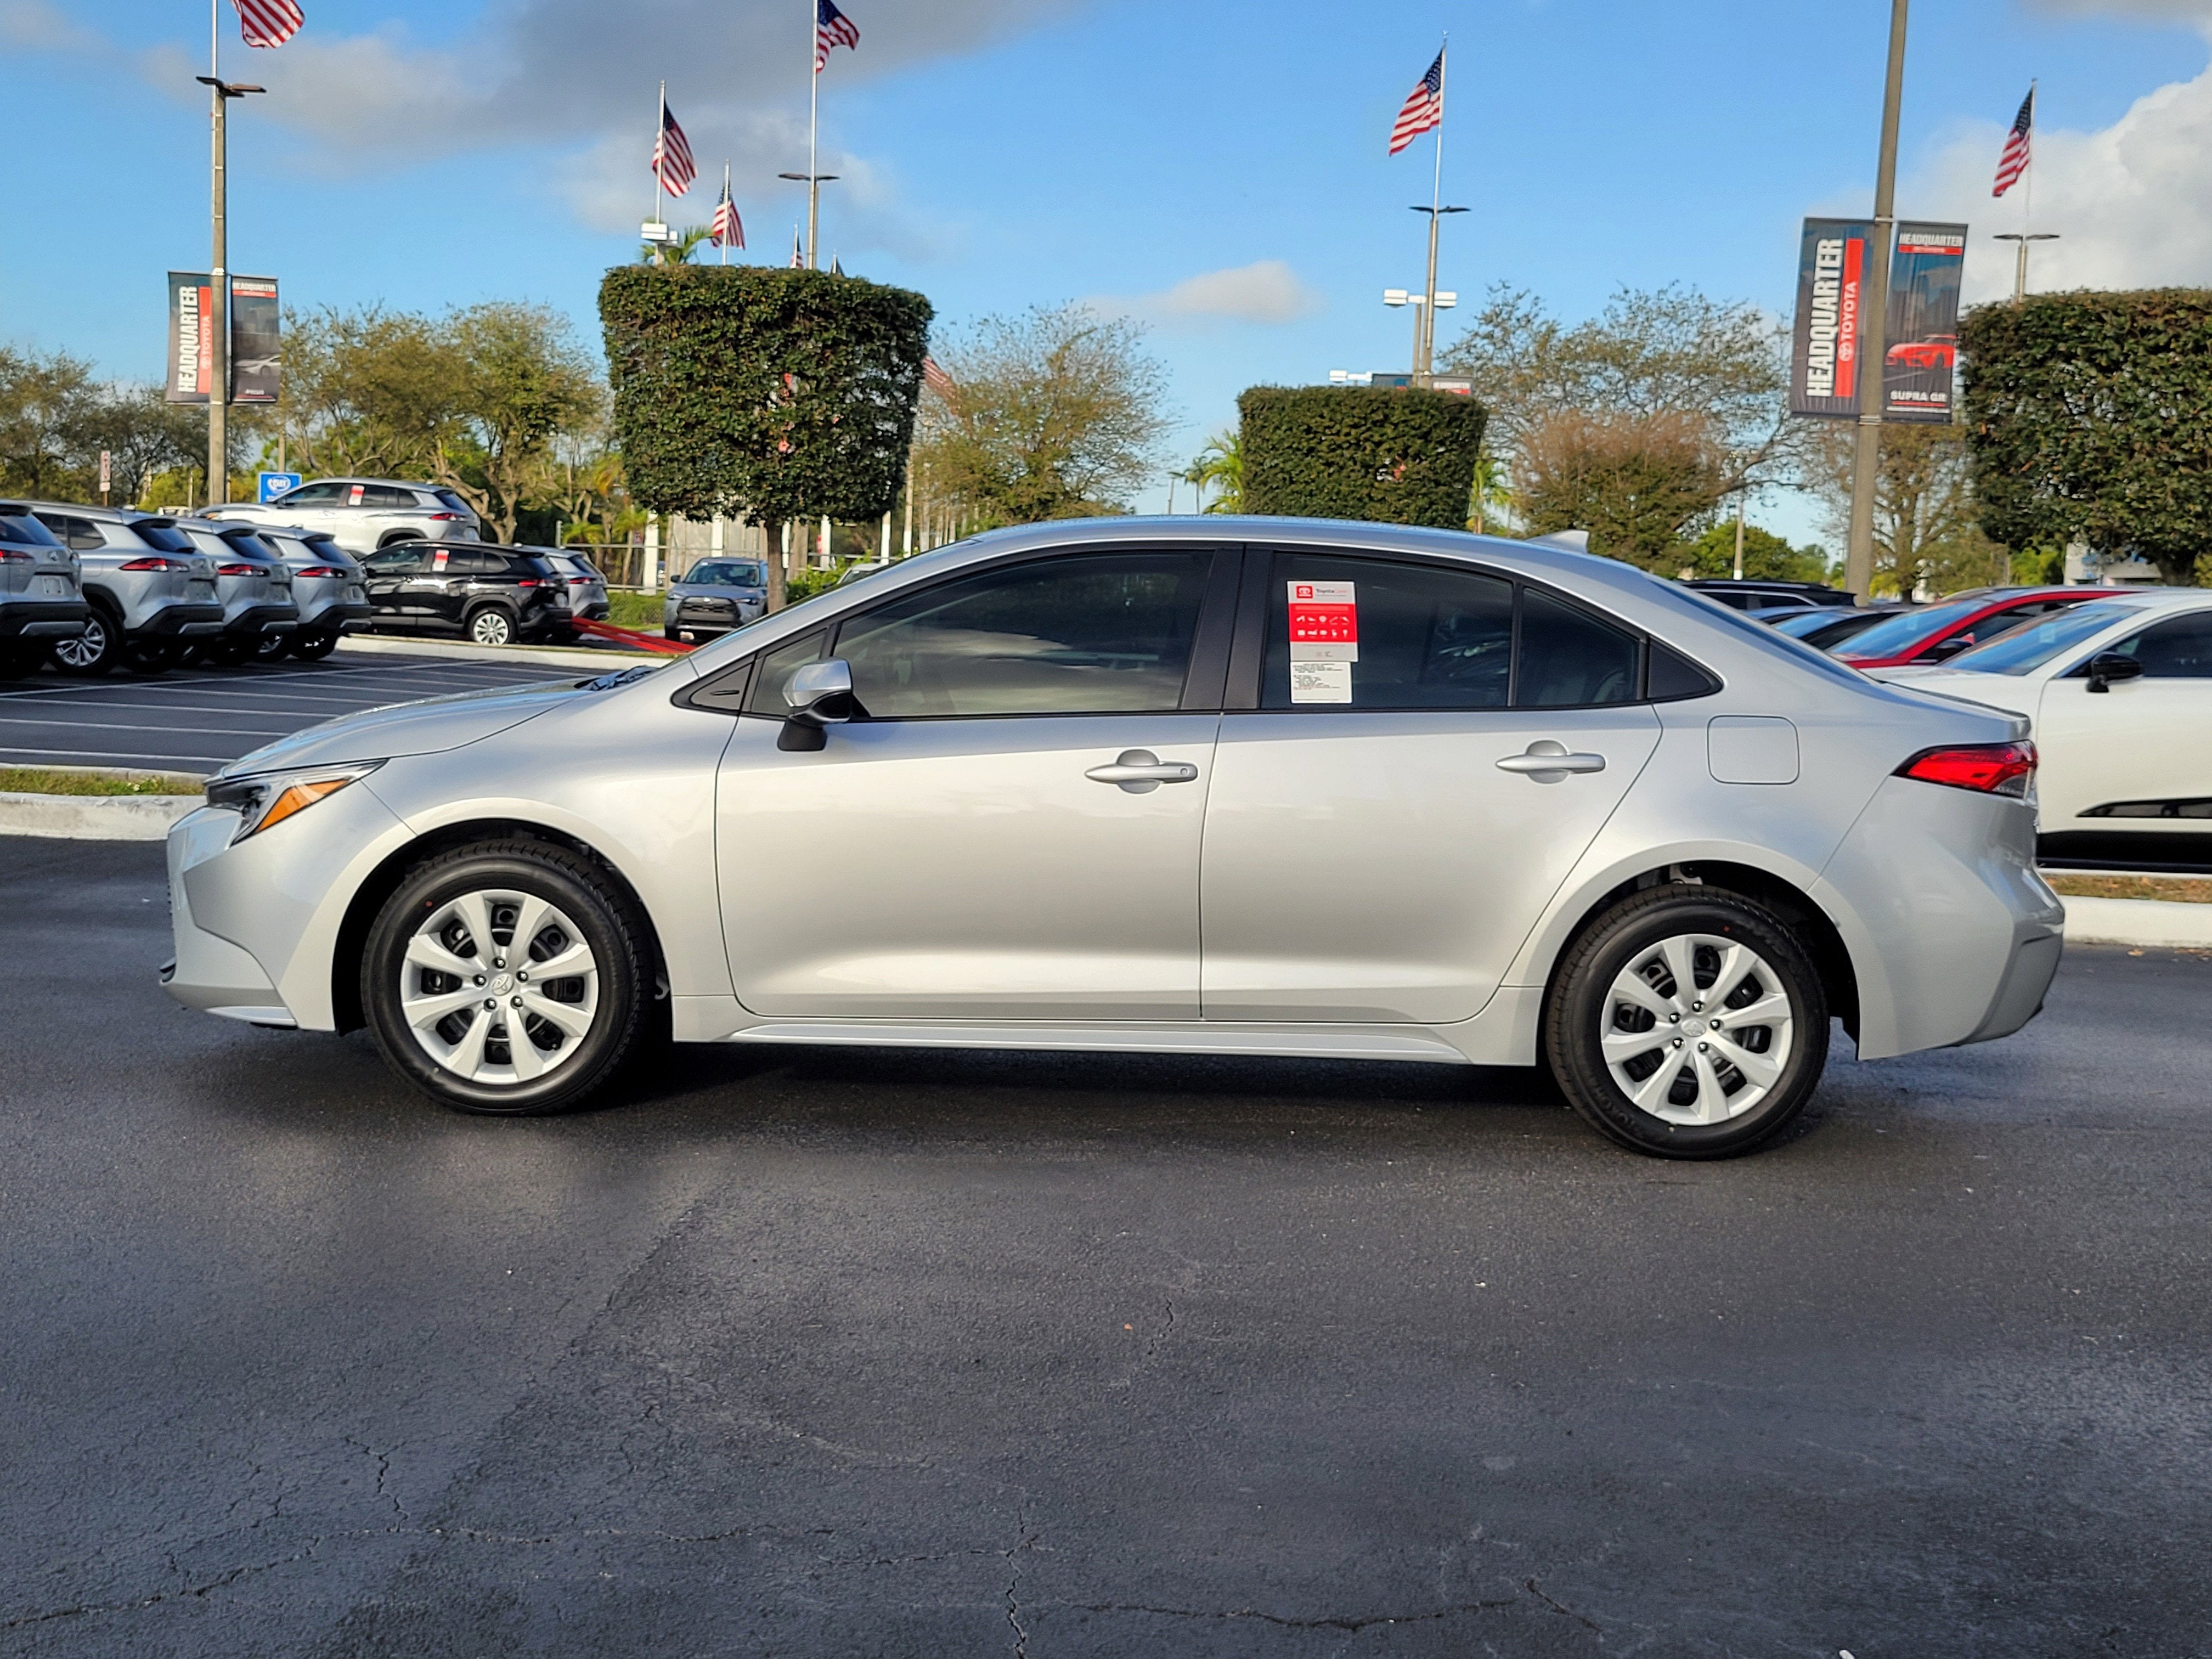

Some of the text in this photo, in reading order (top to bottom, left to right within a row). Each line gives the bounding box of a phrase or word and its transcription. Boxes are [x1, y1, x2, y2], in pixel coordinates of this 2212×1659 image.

[1899, 233, 1962, 246] HEADQUARTER
[201, 315, 211, 355] TOYOTA
[1806, 239, 1843, 397] HEADQUARTER
[1841, 281, 1858, 341] TOYOTA
[178, 286, 200, 392] HEADQUARTER
[1890, 390, 1928, 402] SUPRA
